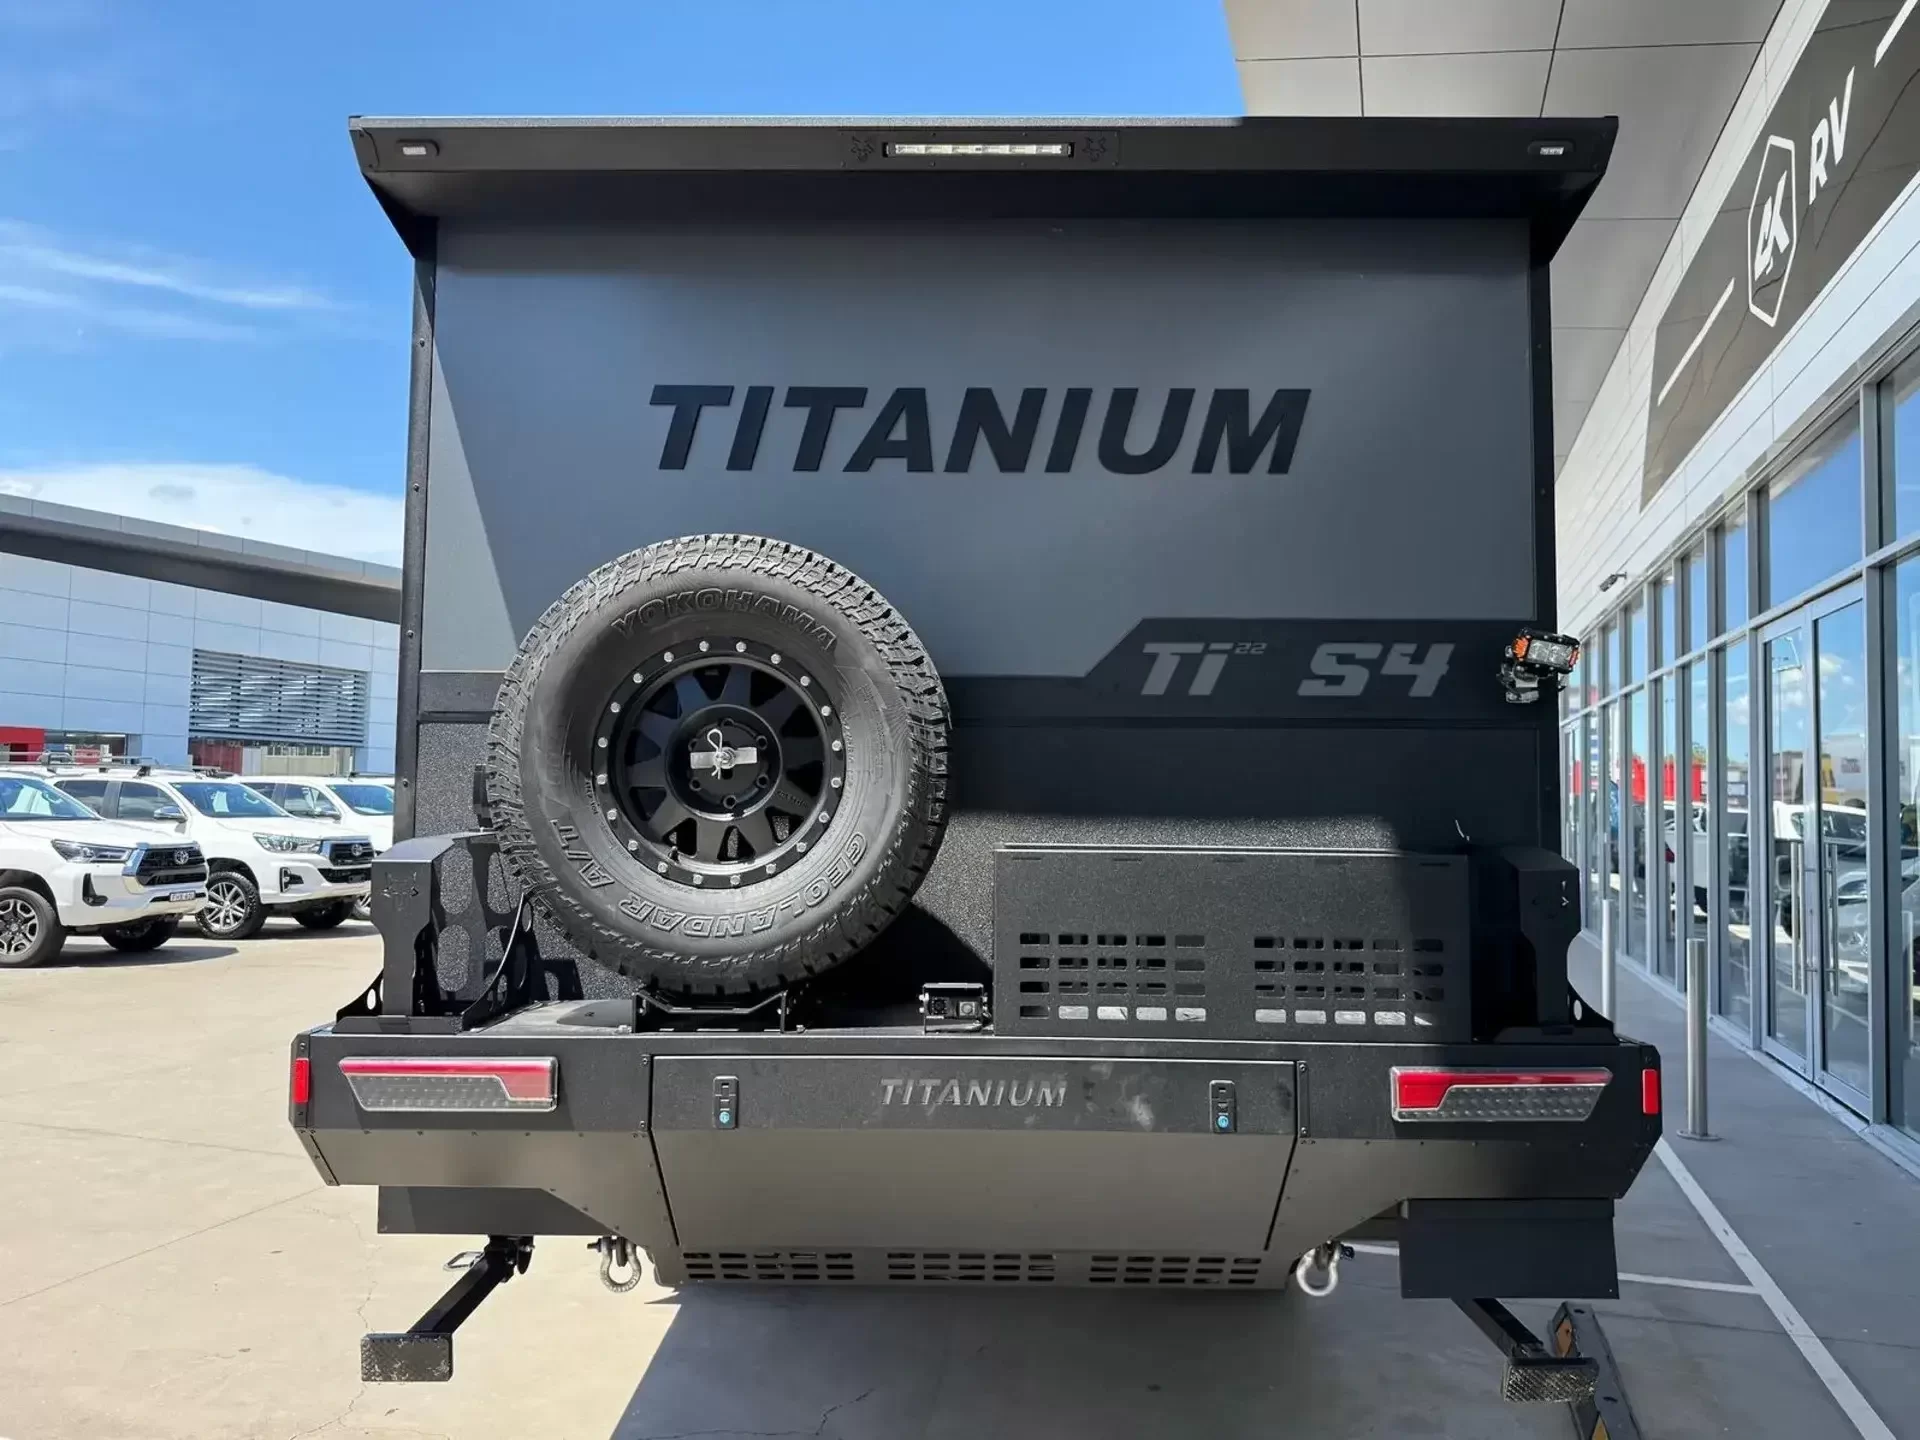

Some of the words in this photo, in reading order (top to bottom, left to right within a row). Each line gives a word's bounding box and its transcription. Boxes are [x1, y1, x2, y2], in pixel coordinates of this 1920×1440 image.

[1808, 66, 1855, 205] RV
[649, 386, 1311, 476] TITANIUM
[611, 588, 837, 653] YOKOHAMA
[550, 818, 615, 888] A/T
[618, 832, 868, 940] GEOLANDAR
[879, 1078, 1068, 1108] TITANIUM
